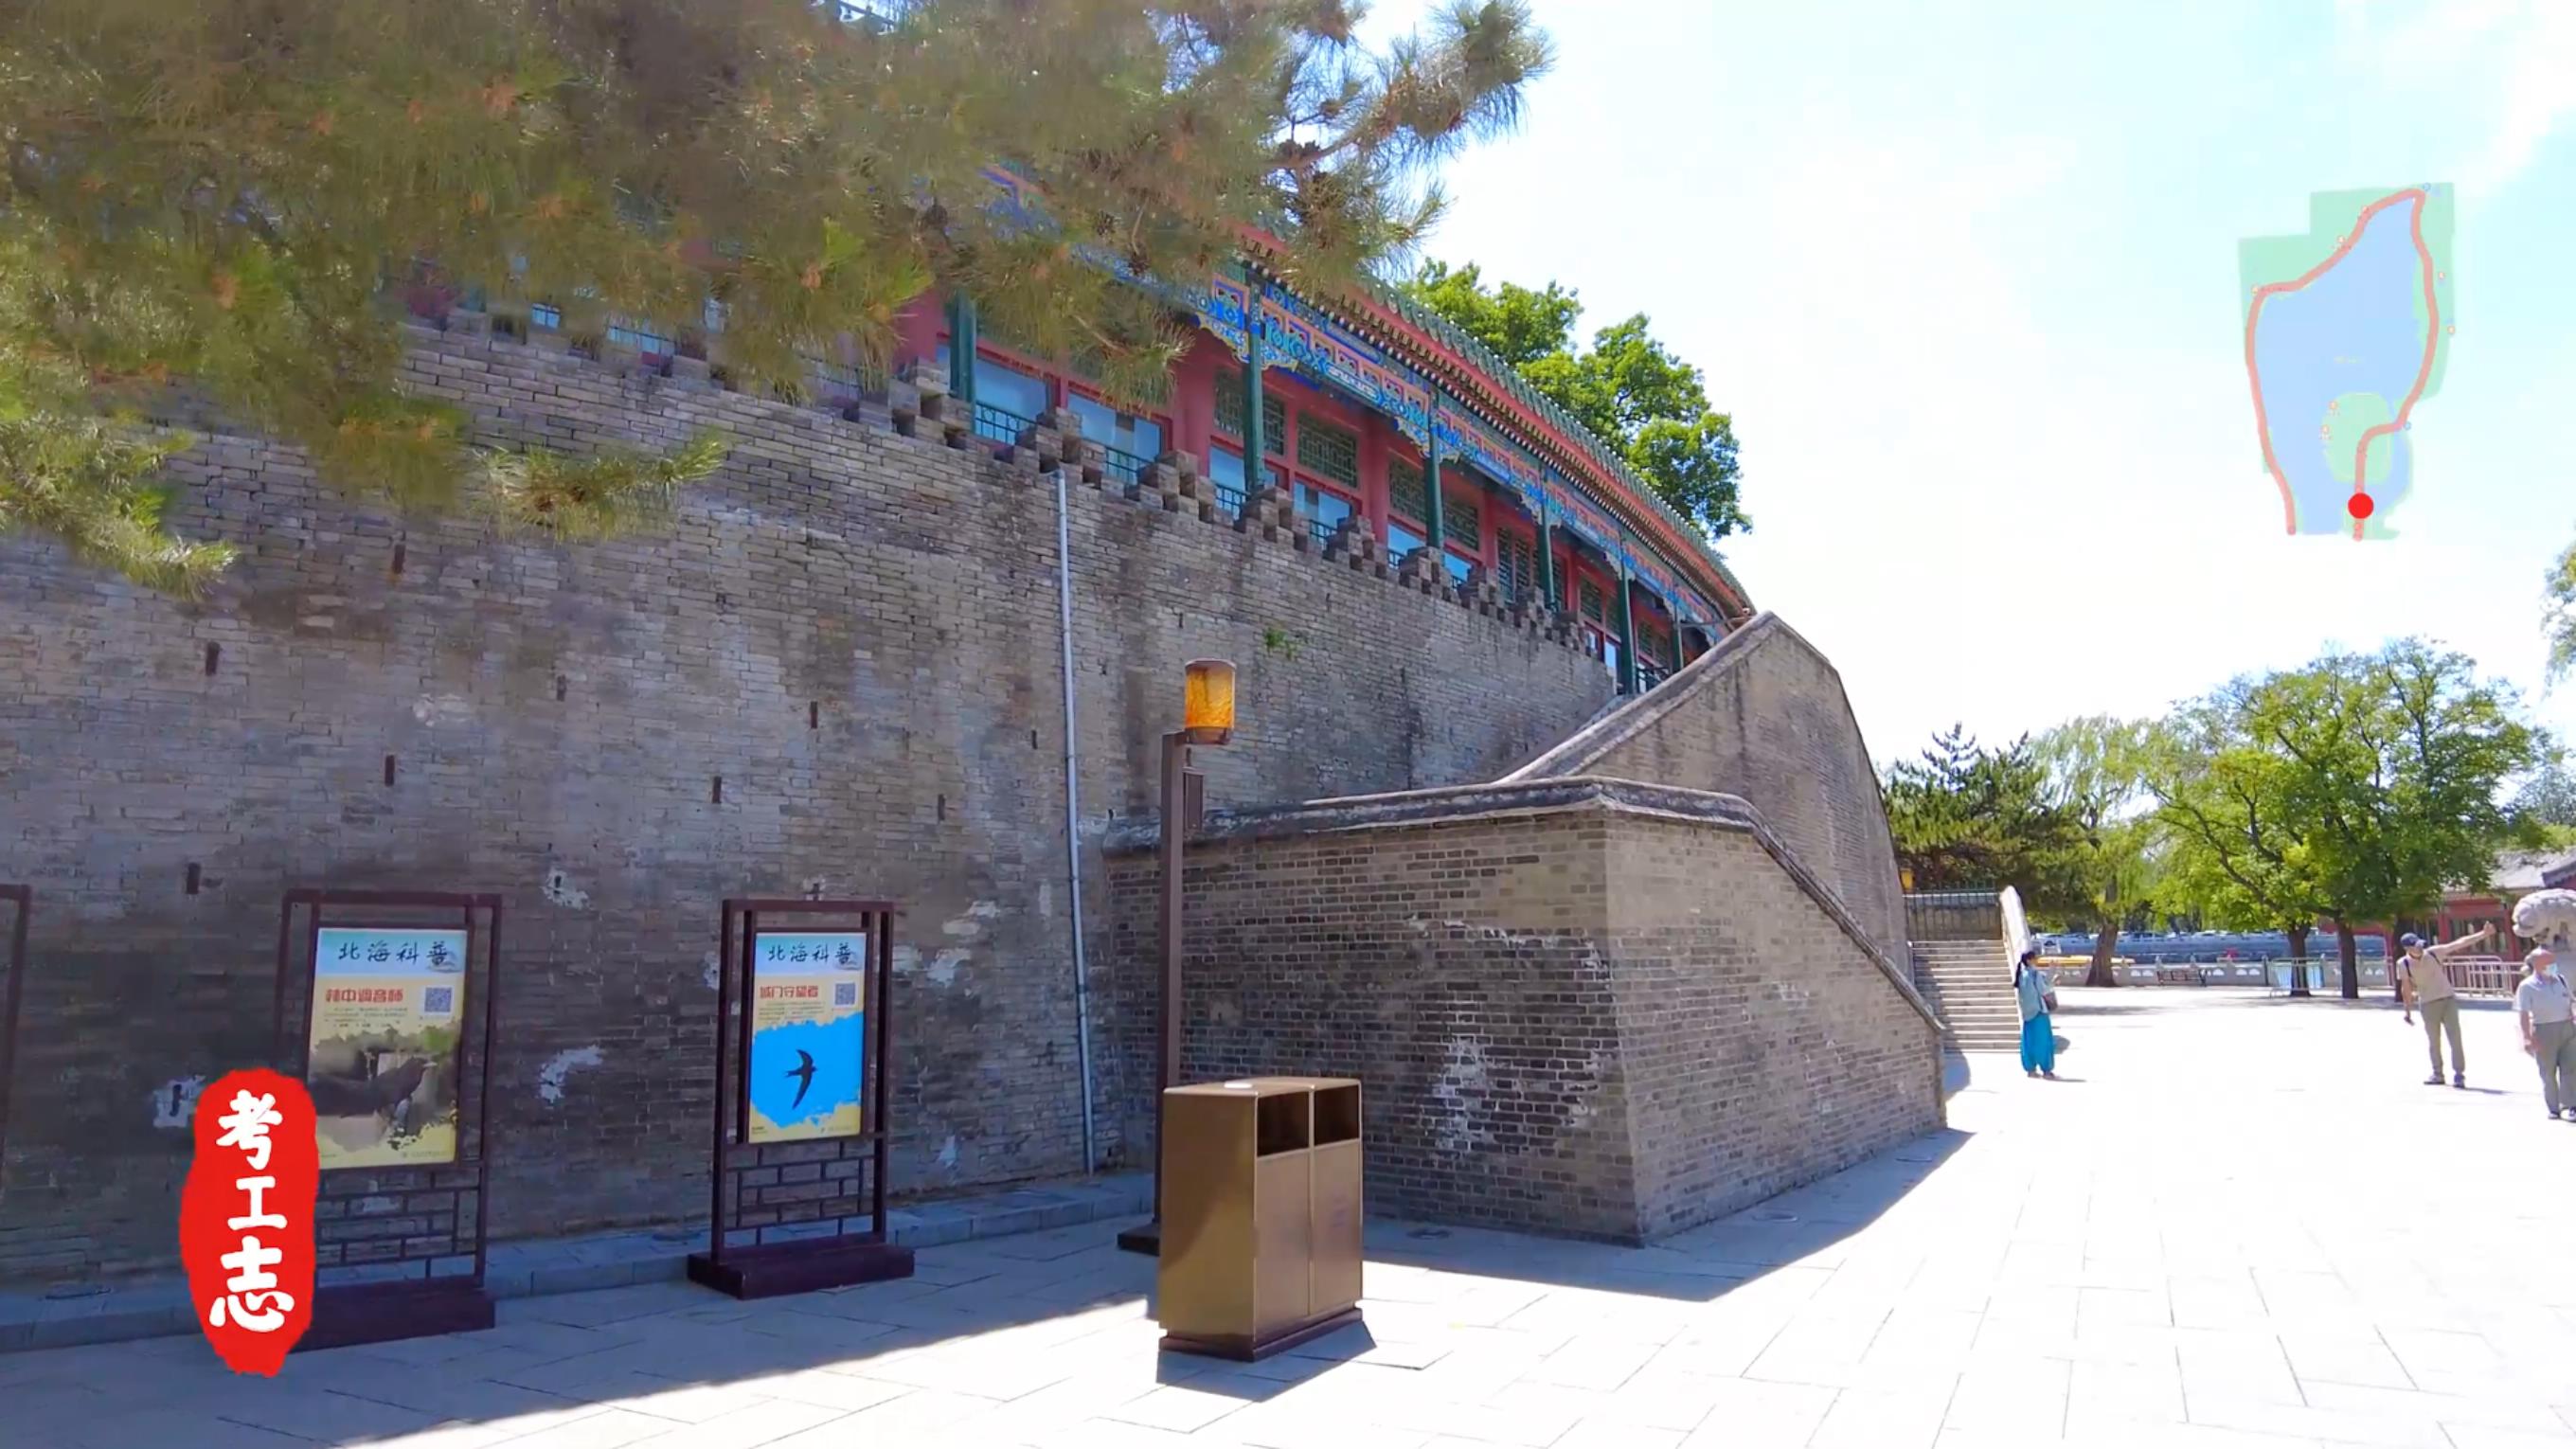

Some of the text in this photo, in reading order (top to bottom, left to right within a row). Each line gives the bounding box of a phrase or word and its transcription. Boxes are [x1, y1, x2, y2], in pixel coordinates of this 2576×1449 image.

[338, 939, 448, 965] 北海科普
[768, 941, 851, 964] 北海科普
